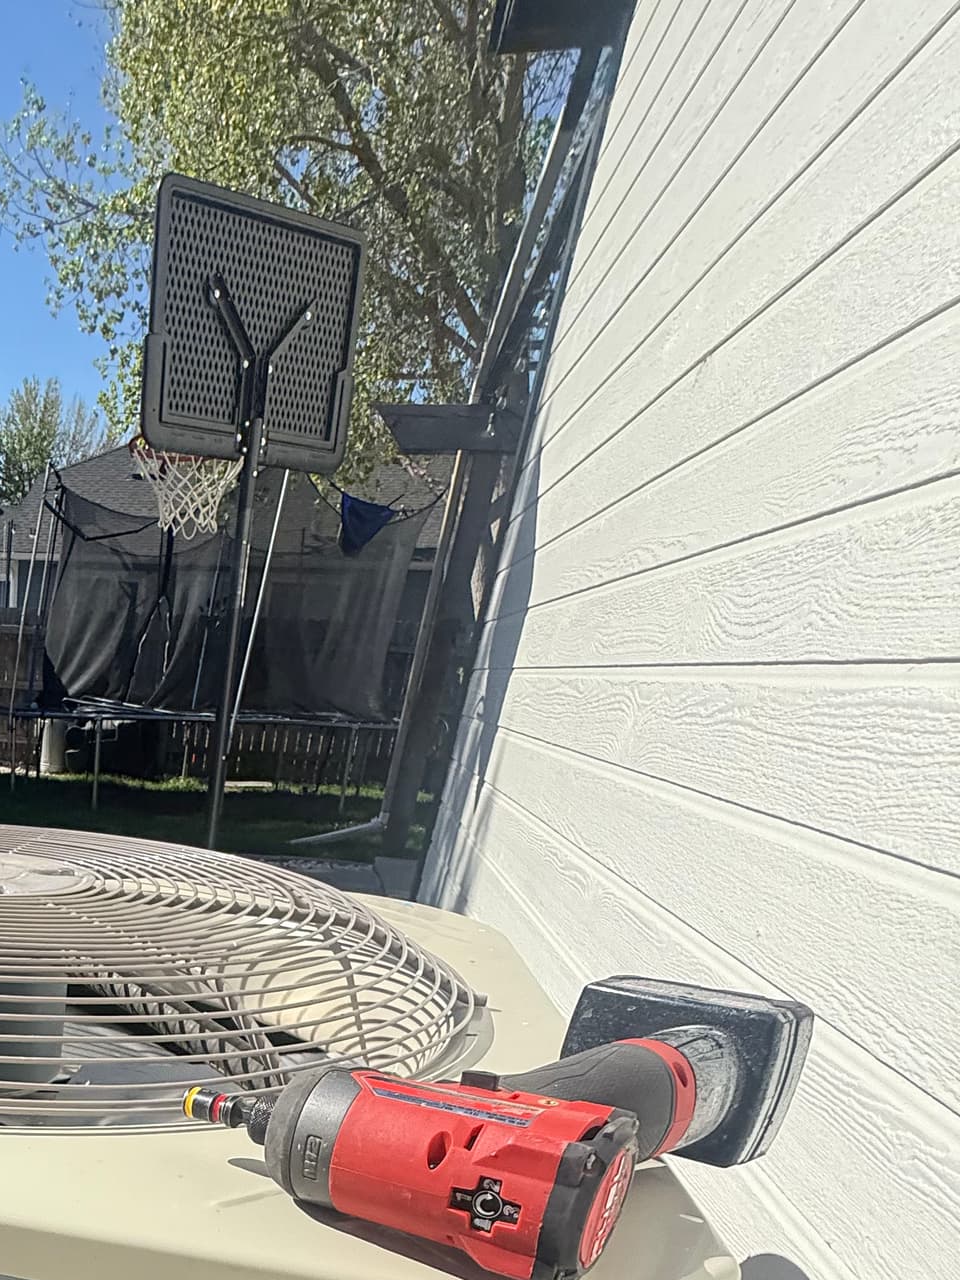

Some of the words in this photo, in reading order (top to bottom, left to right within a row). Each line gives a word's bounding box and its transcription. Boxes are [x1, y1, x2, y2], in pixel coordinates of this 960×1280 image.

[483, 1178, 501, 1193] 2
[455, 1192, 473, 1202] 1
[503, 1204, 519, 1218] 3
